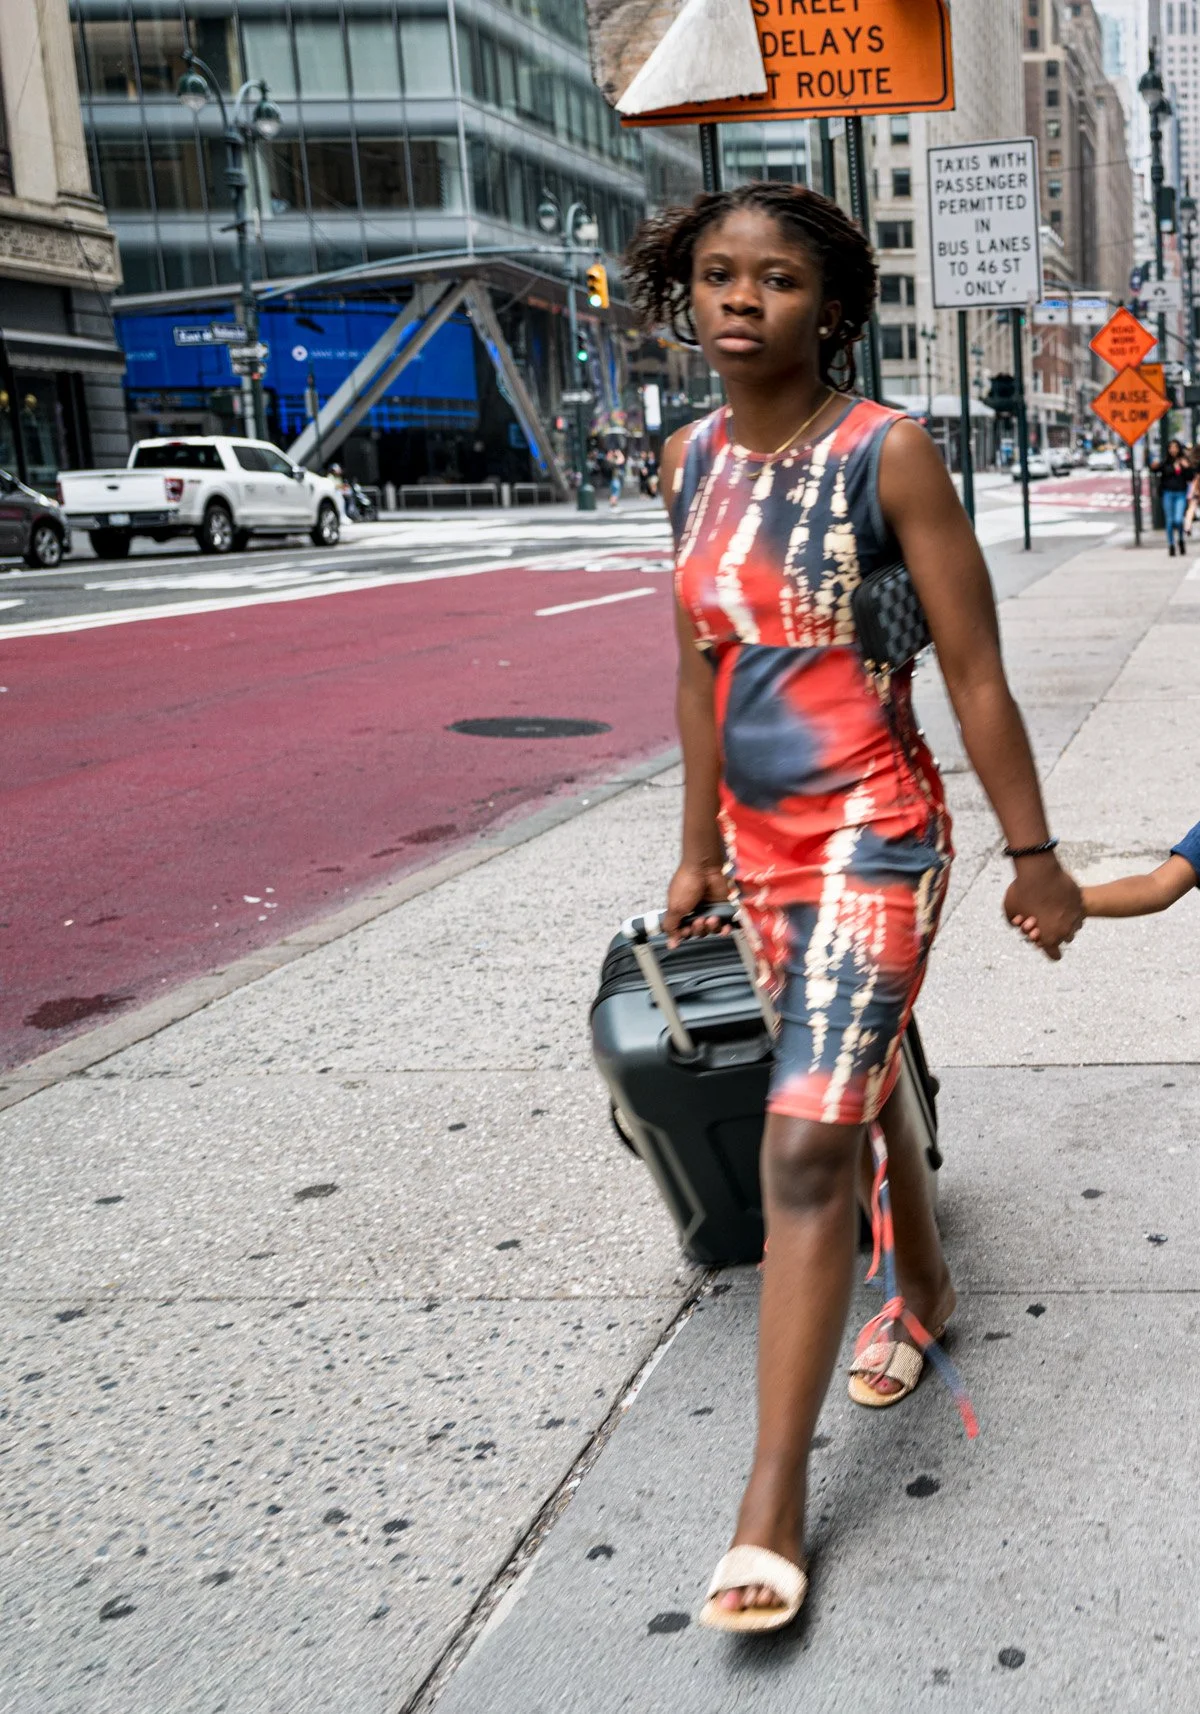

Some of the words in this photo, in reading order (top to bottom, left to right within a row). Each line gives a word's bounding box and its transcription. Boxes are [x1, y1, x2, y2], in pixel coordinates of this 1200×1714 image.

[762, 26, 885, 58] DELAYS
[798, 67, 893, 98] ROUTE
[936, 155, 980, 174] TAXIS
[988, 152, 1027, 169] WITH
[936, 173, 1028, 194] PASSENGER
[938, 194, 1027, 215] PERMITTED
[975, 218, 990, 233] IN
[938, 240, 969, 257] BUS
[976, 236, 1031, 255] LANES
[949, 260, 968, 277] TO
[978, 259, 998, 275] 46
[1003, 257, 1023, 274] ST
[964, 280, 1006, 297] ONLY
[1109, 389, 1151, 404] RAISE
[1110, 408, 1149, 423] PLOW
